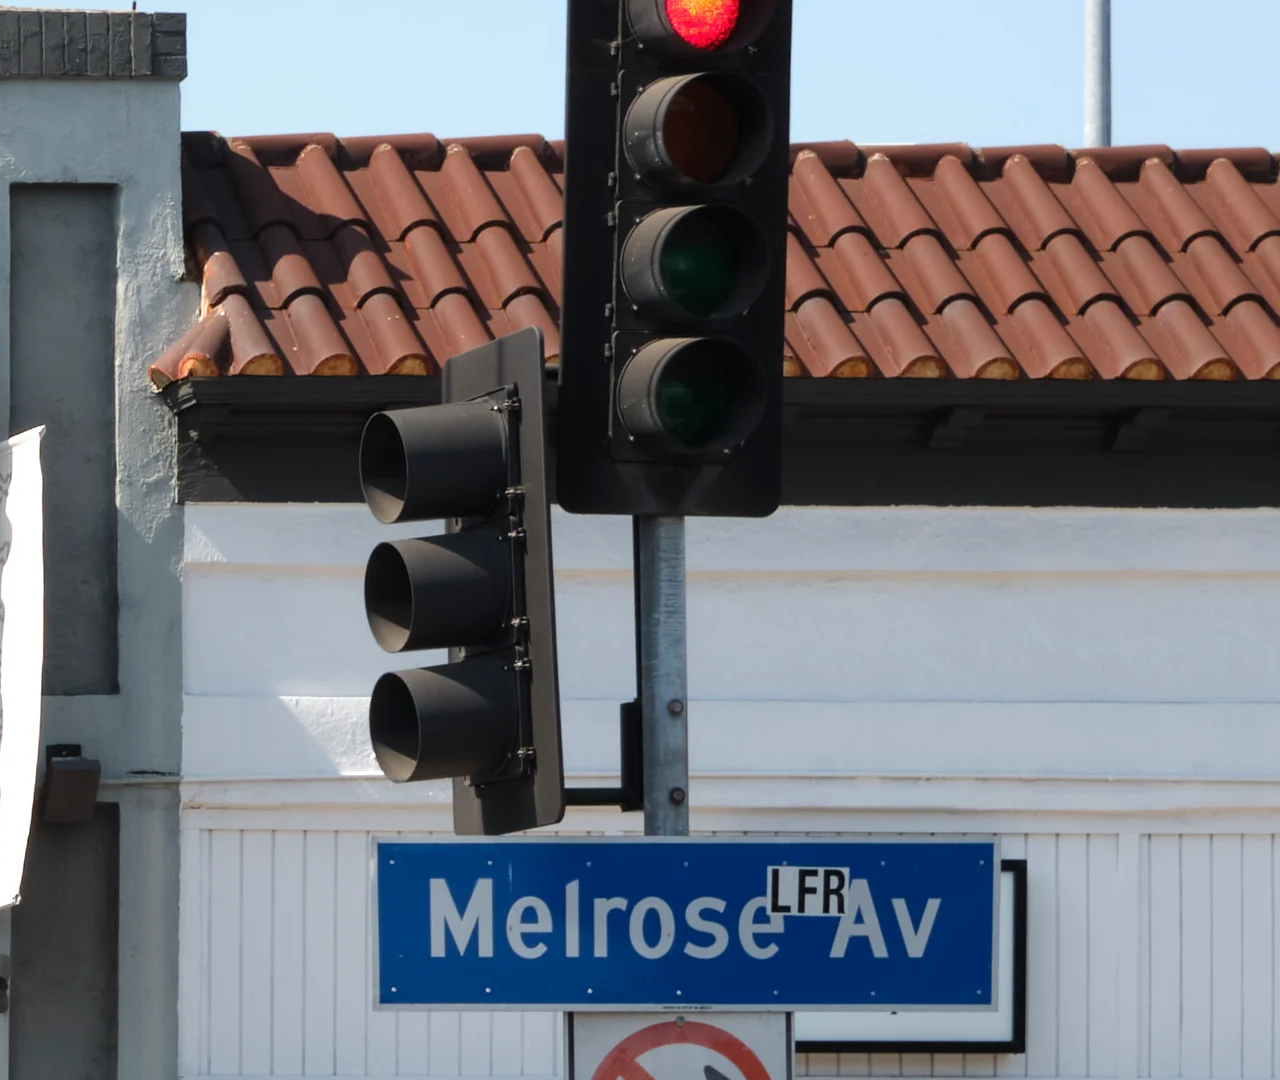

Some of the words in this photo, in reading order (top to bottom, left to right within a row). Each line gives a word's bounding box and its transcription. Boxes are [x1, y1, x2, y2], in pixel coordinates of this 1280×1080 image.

[429, 878, 785, 959] Melrose
[828, 878, 943, 959] Av
[770, 868, 846, 914] LFR
